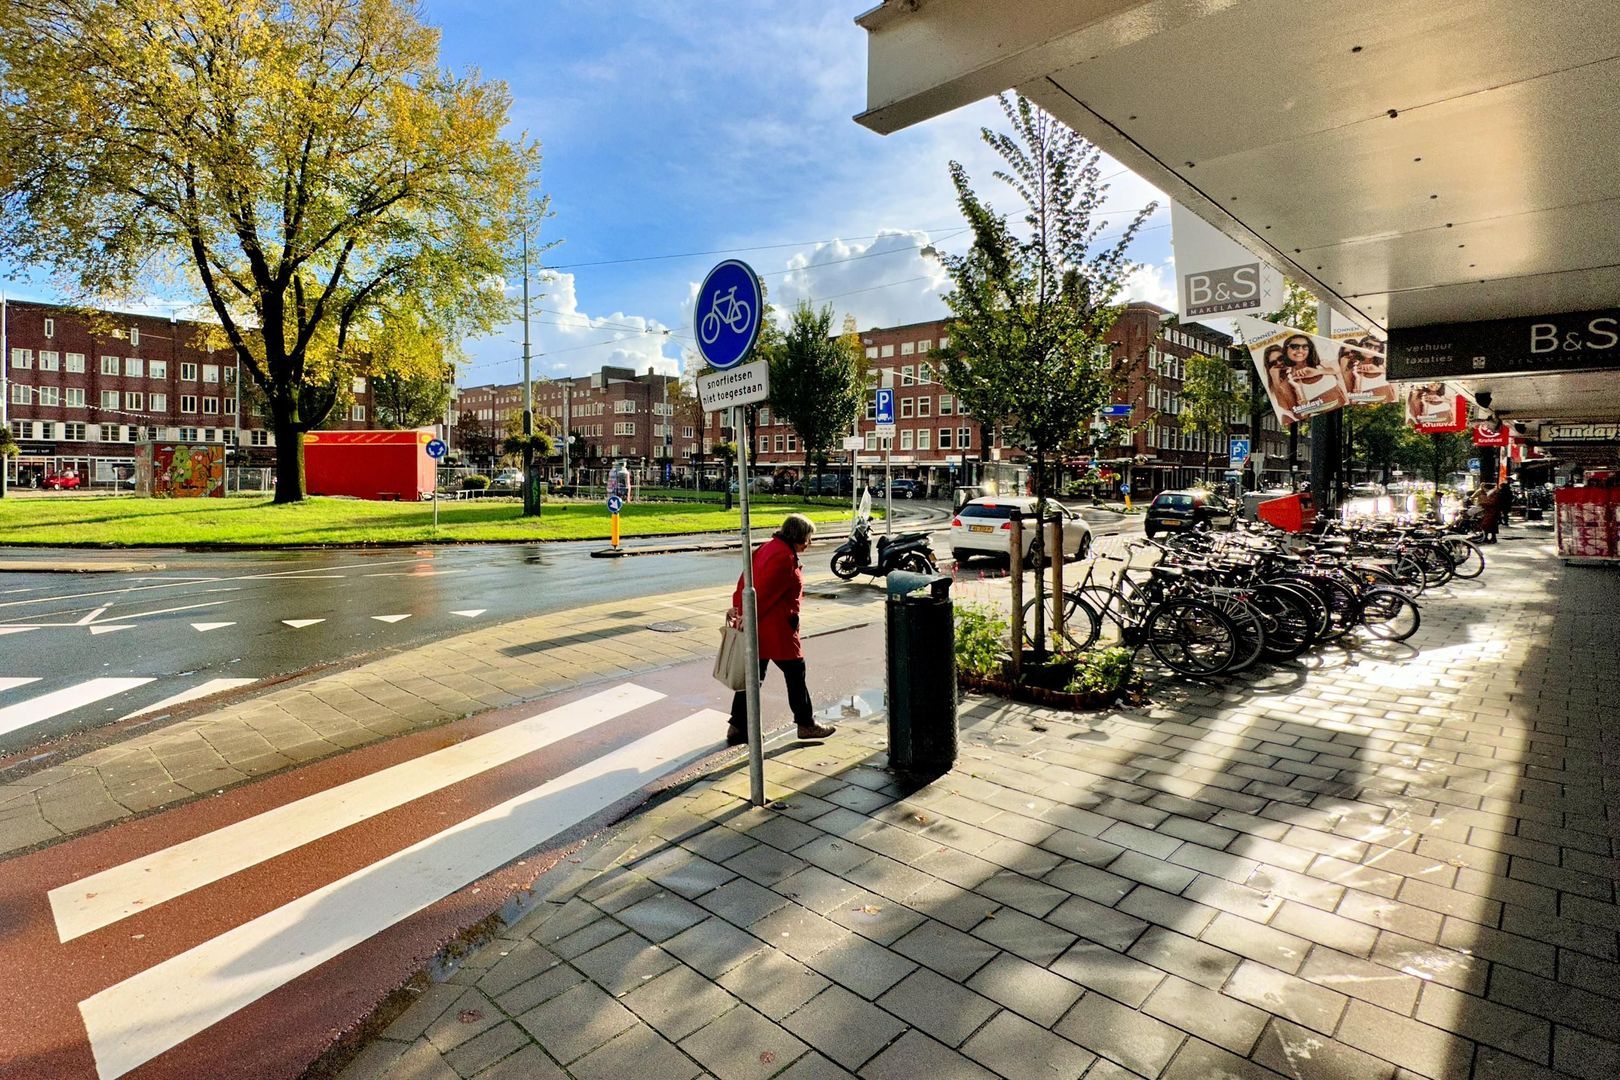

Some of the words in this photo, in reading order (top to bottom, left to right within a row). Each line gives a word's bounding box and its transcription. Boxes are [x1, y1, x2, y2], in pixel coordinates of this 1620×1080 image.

[1190, 267, 1257, 305] B&S
[1190, 300, 1256, 315] MAKELAARS
[1248, 329, 1277, 344] ZONNEN
[1530, 317, 1619, 354] B&S
[1406, 343, 1453, 352] verhuur
[1405, 355, 1453, 365] taxaties
[707, 371, 752, 389] snorfietsen
[703, 393, 716, 405] niet
[718, 383, 763, 400] toegestaan
[880, 392, 889, 410] P
[1550, 424, 1620, 440] Sunday
